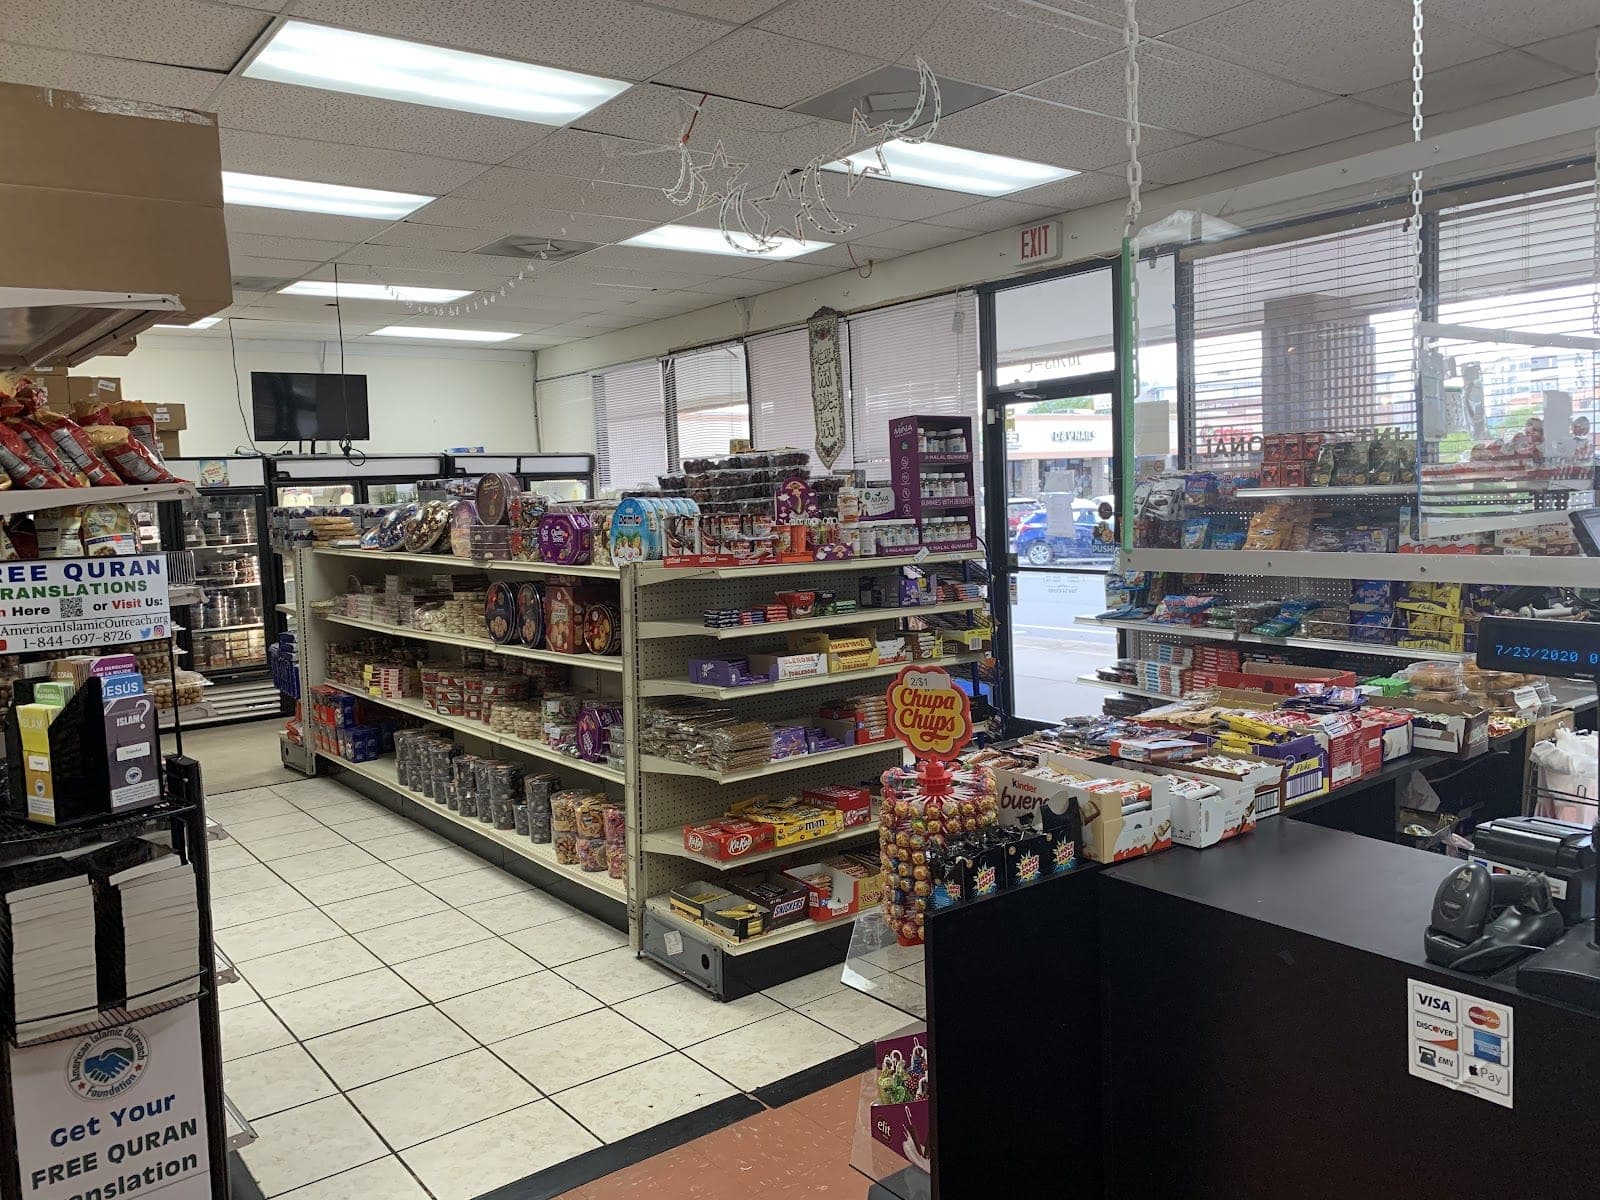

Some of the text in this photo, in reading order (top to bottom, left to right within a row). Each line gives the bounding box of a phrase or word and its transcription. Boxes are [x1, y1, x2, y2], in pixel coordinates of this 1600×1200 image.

[1021, 224, 1050, 260] EXIT
[1092, 544, 1113, 553] PUSH
[64, 559, 161, 580] QURAN
[0, 580, 147, 600] RANSLATIONS
[12, 606, 50, 617] Here
[93, 602, 107, 611] or
[112, 599, 141, 609] Visit
[145, 598, 163, 607] Us:
[1, 615, 169, 637] AmericanIslamicOutreach.org
[22, 630, 132, 649] 1-844-697-8726
[1495, 644, 1578, 662] 7/23/2020
[102, 681, 138, 697] JESÚS
[900, 687, 956, 715] Chupa
[900, 708, 956, 733] Chups
[775, 898, 805, 915] SNICKERS
[1417, 992, 1451, 1013] VISA
[1416, 1020, 1454, 1037] DISCOVER
[70, 1027, 149, 1082] American Islamic Outreach
[1438, 1057, 1454, 1067] EMV
[86, 1074, 137, 1098] Foundation
[1480, 1067, 1503, 1086] Pay
[50, 1094, 176, 1147] Get Your
[877, 1120, 891, 1137] elit
[31, 1118, 198, 1190] FREE QURAN
[68, 1153, 198, 1200] nslation
